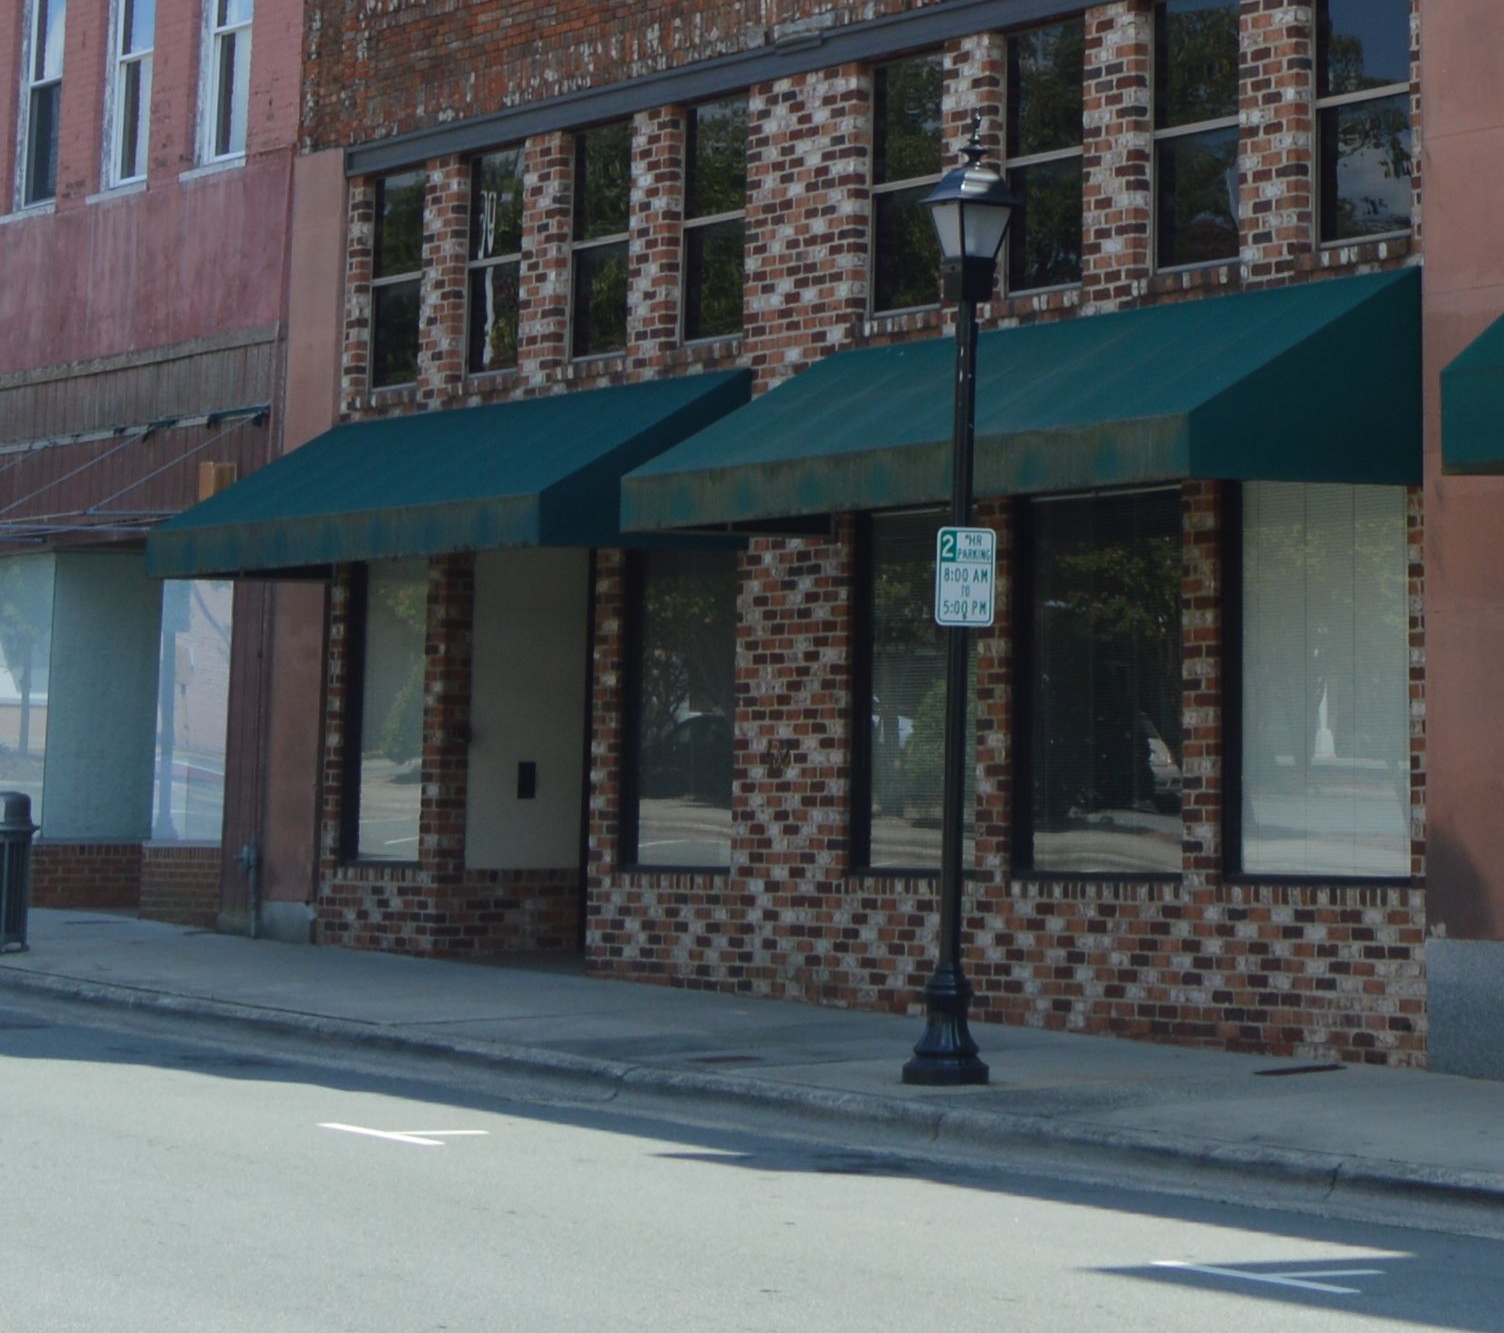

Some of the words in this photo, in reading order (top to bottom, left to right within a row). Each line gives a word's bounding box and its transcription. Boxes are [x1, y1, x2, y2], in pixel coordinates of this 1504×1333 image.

[942, 535, 954, 558] 2
[958, 549, 991, 561] PARKING
[944, 567, 969, 582] 8:00
[973, 568, 988, 583] AM
[943, 600, 968, 614] 5:00
[972, 600, 987, 615] PM
